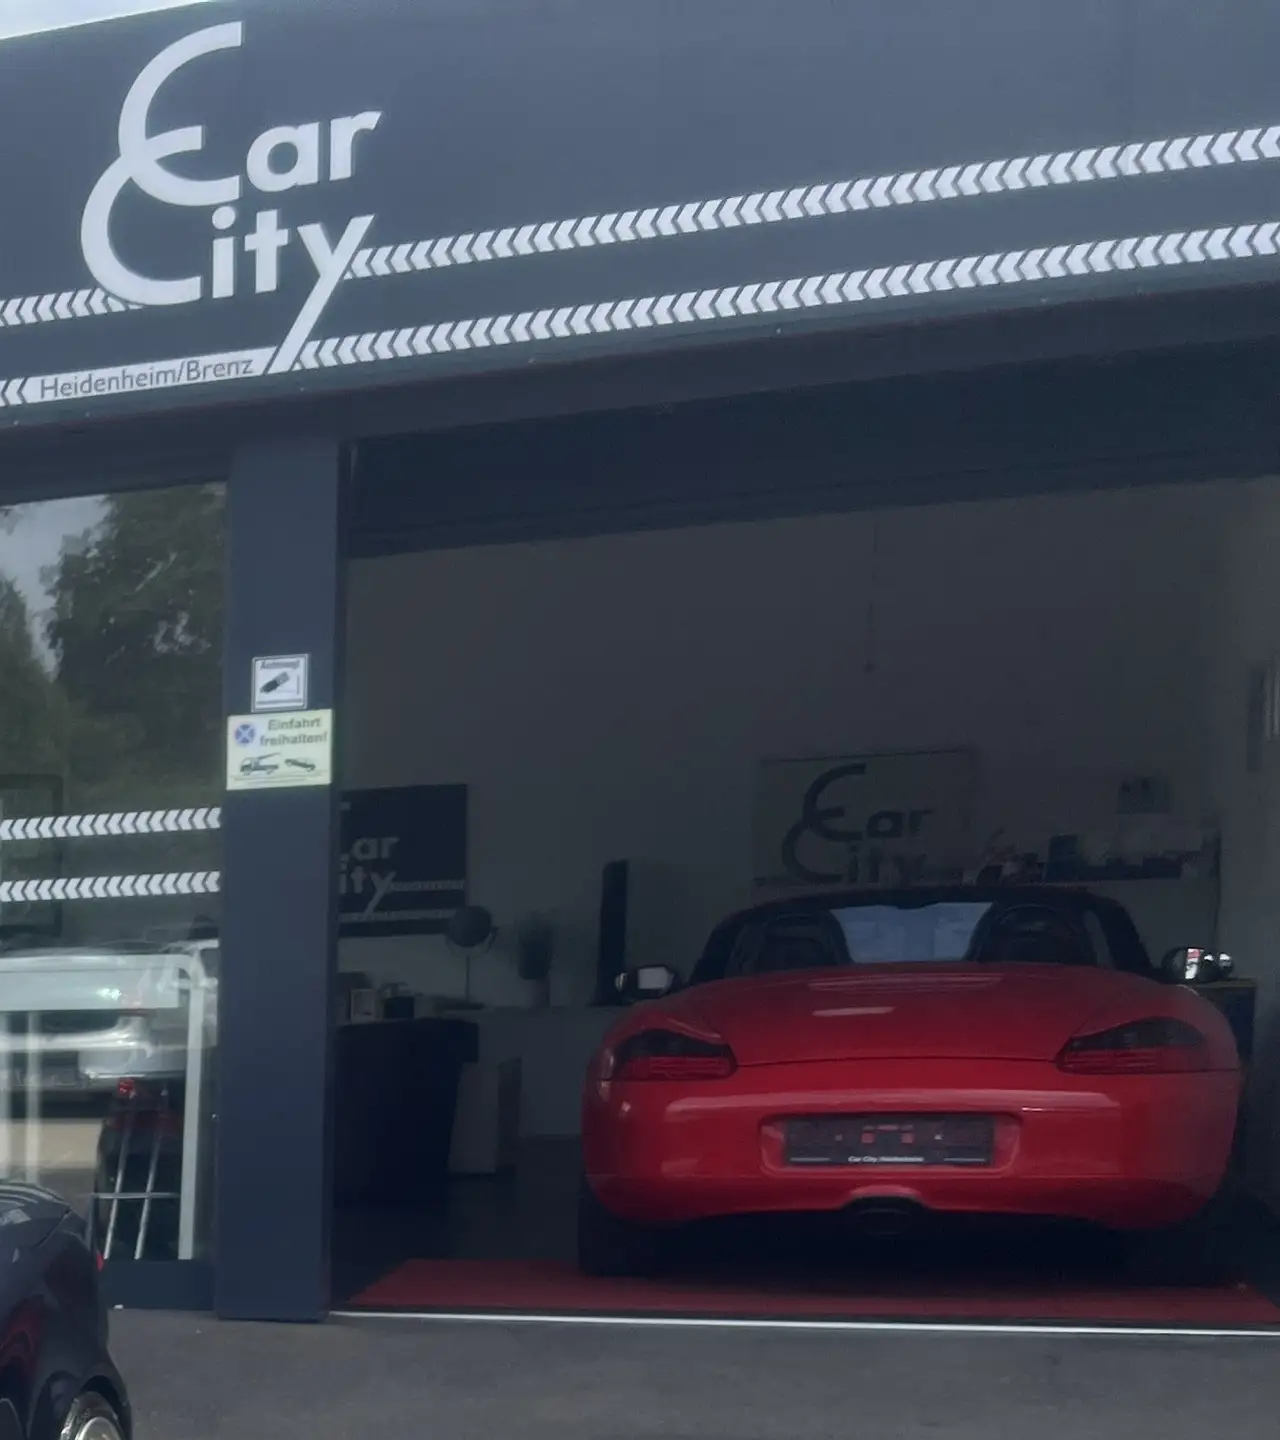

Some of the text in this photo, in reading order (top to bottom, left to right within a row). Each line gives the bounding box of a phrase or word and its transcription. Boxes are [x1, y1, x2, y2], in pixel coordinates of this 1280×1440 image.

[80, 126, 375, 374] City
[40, 358, 253, 401] Heidenheim/Brenz
[268, 718, 321, 731] Einfahrt
